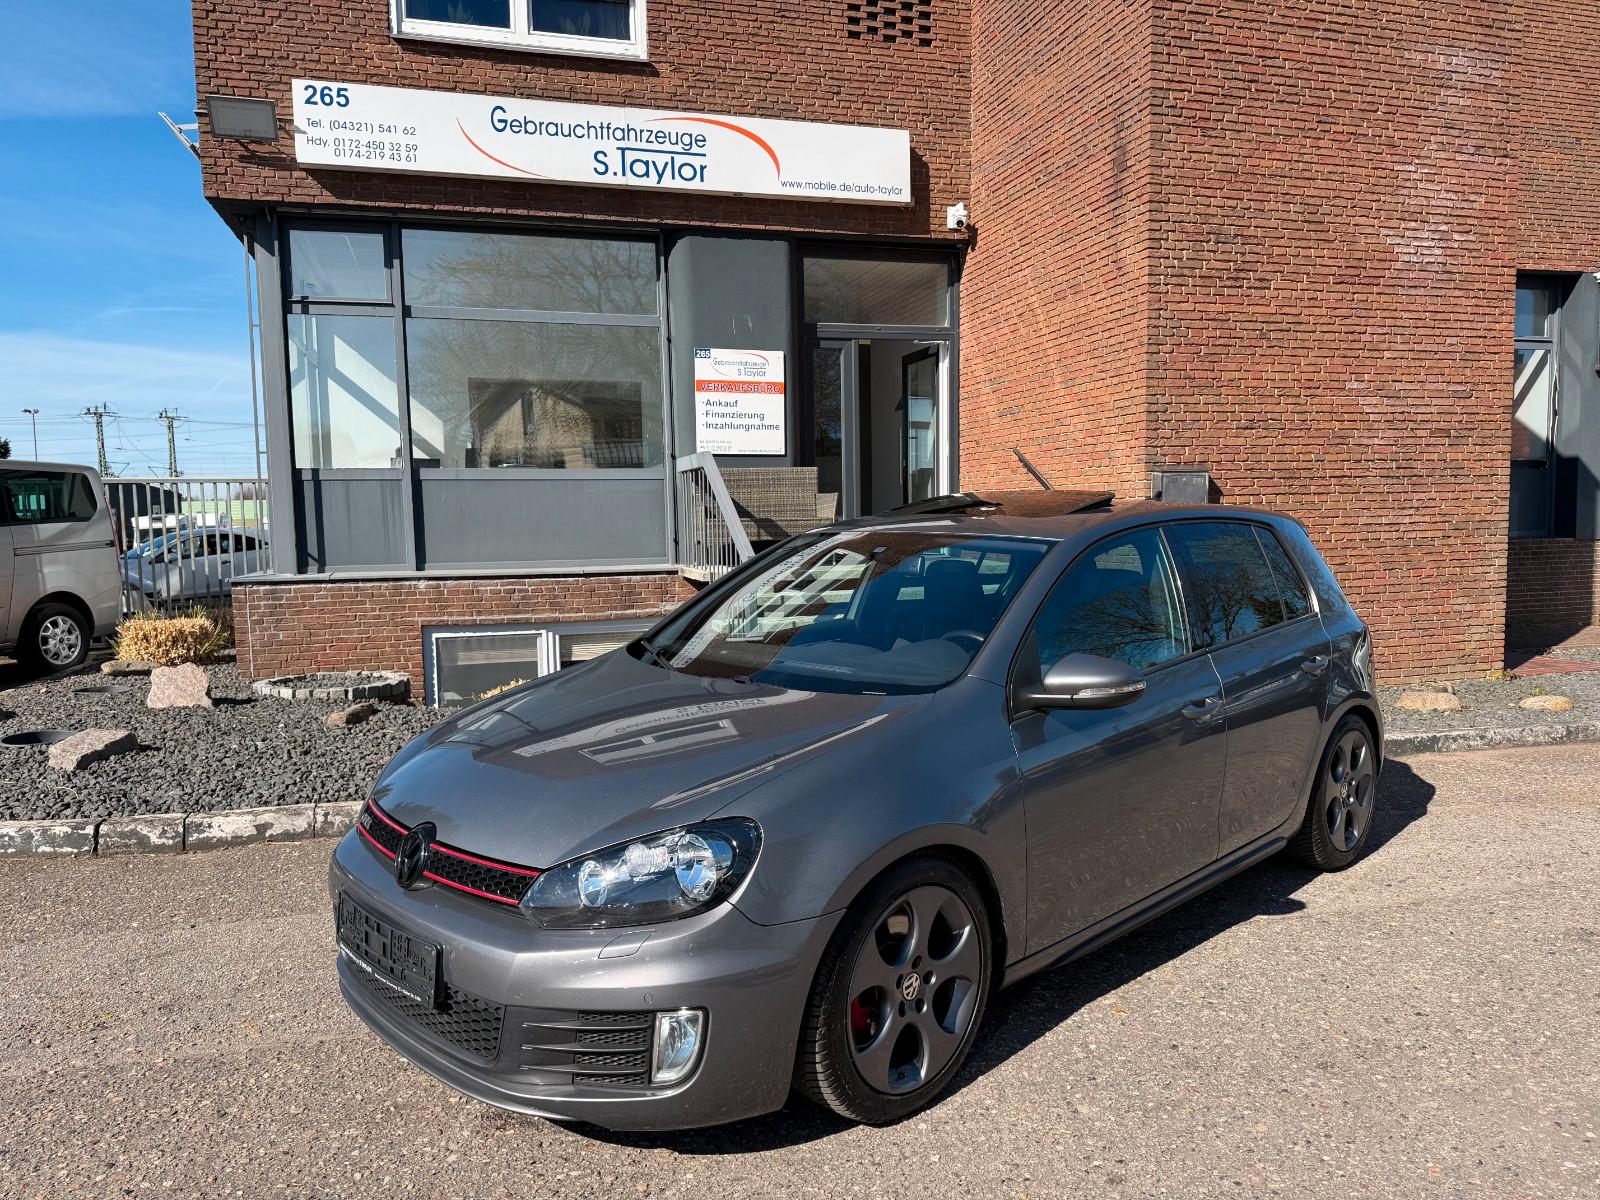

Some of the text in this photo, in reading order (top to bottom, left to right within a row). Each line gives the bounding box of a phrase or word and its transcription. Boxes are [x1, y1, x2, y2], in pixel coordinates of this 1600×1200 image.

[303, 84, 350, 108] 265
[305, 117, 416, 136] Tel. (04321) 541 62
[490, 105, 707, 151] Gebrauchtfahrzeuge
[306, 136, 418, 153] Hdy. 0172-450 32 59
[334, 148, 417, 163] 0174-219 43 61
[593, 146, 707, 185] S.Taylor
[780, 179, 903, 196] www.mobile.de/auto-taylor
[696, 350, 710, 358] 265
